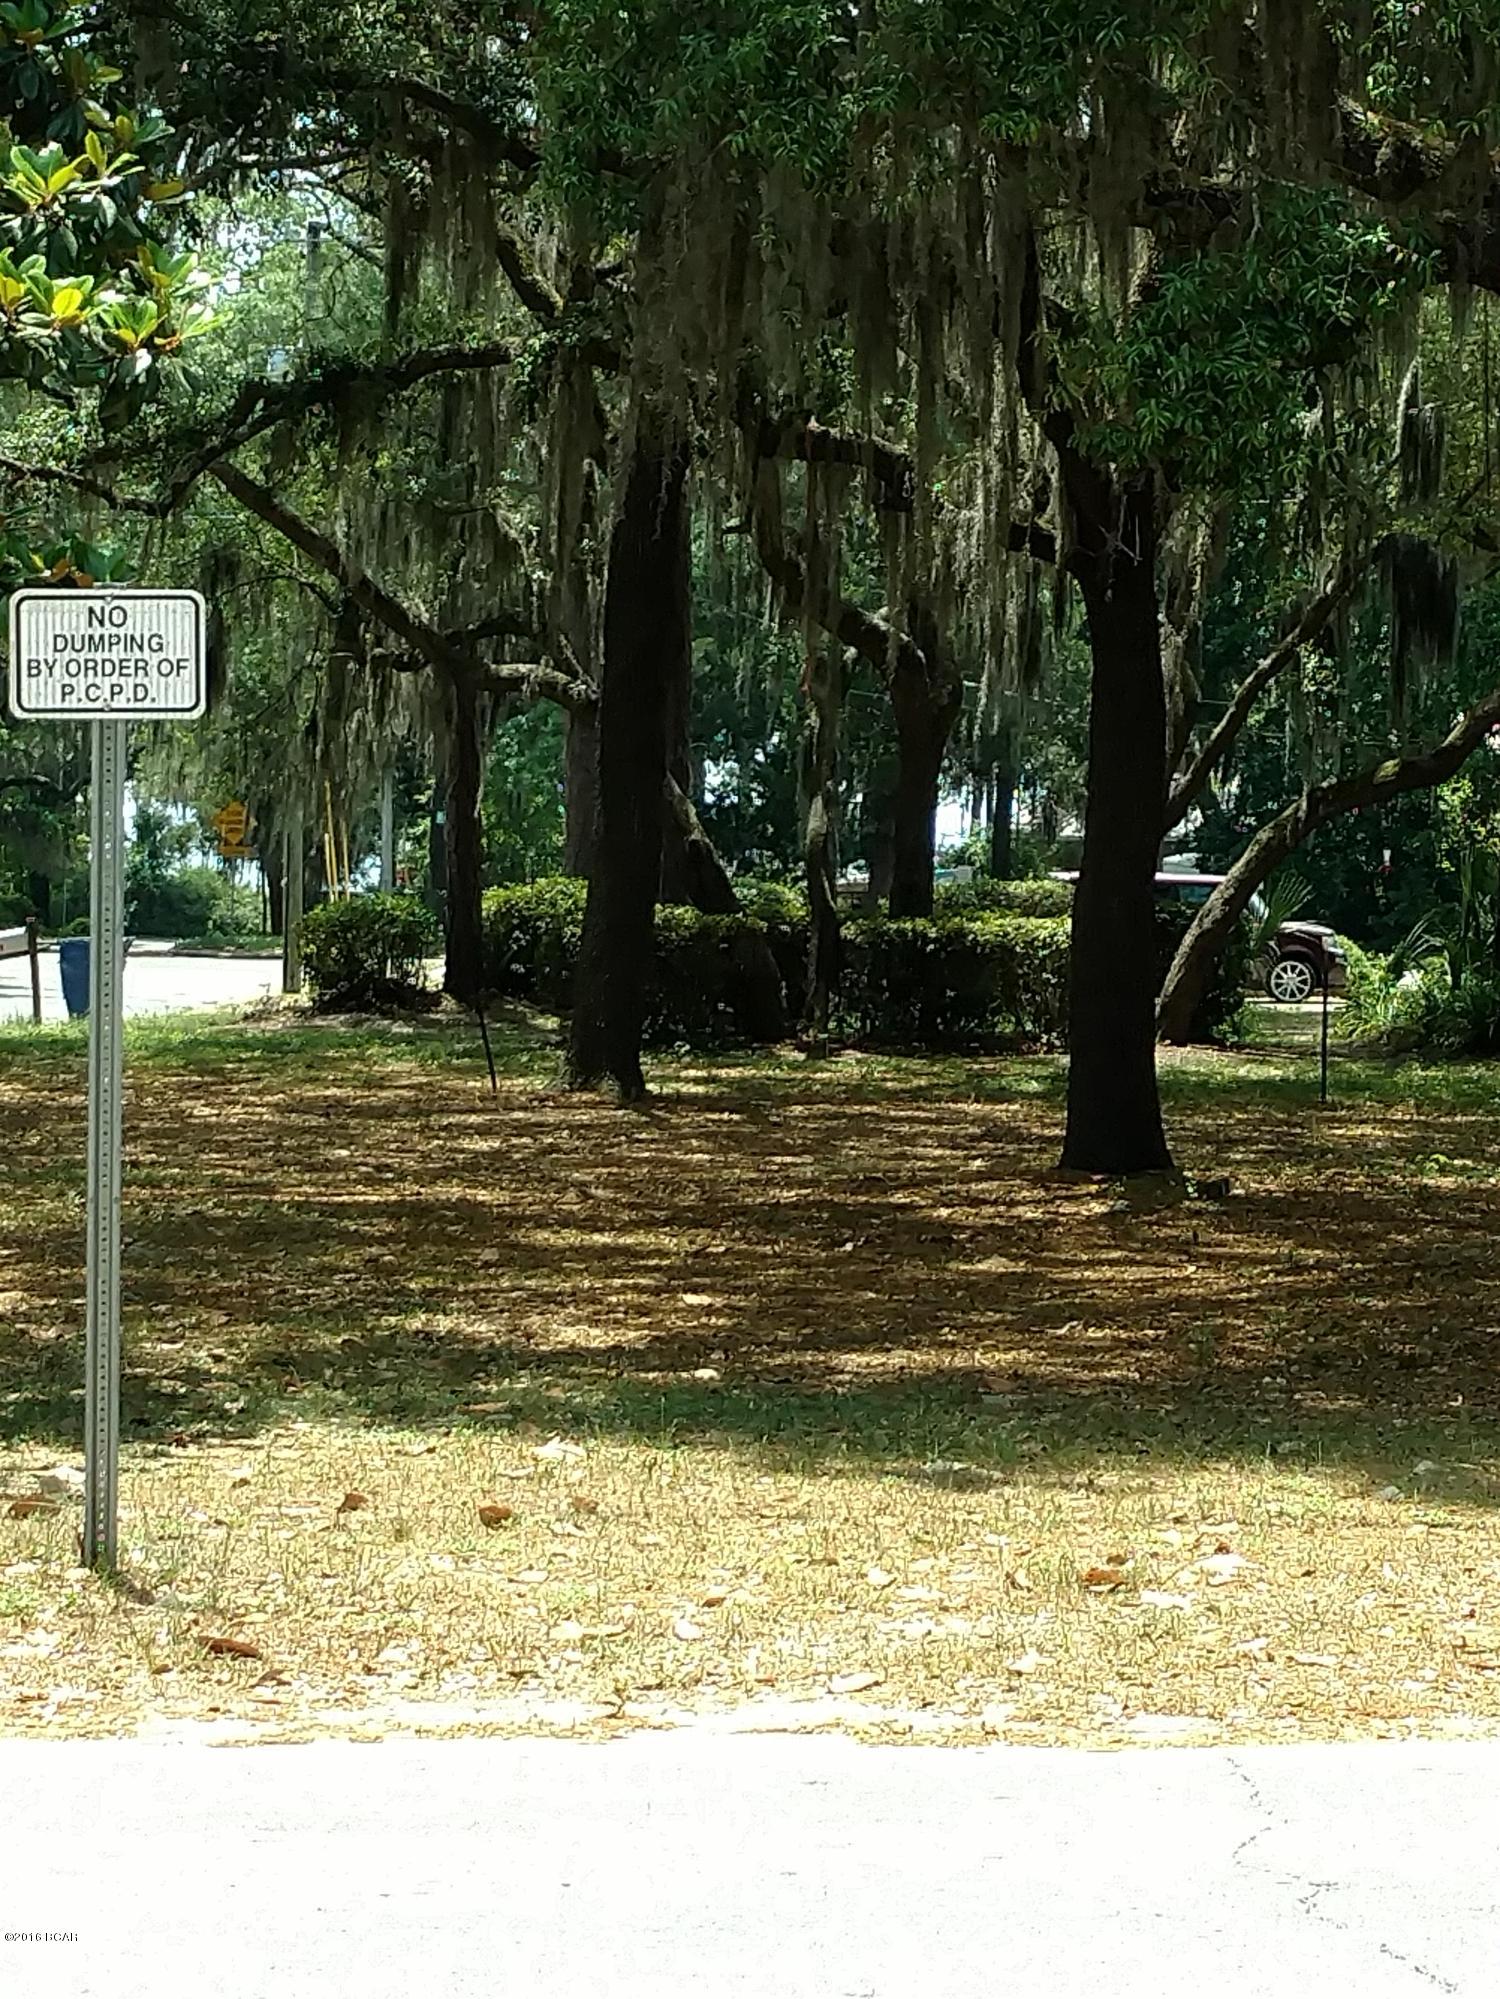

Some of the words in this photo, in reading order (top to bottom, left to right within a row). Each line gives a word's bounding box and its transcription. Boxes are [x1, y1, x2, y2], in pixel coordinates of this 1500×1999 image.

[88, 606, 128, 628] NO
[53, 633, 164, 653] DUMPING
[27, 659, 57, 678] BY
[65, 658, 149, 678] ORDER
[157, 658, 190, 678] OF
[61, 683, 156, 703] P.C.P.D.
